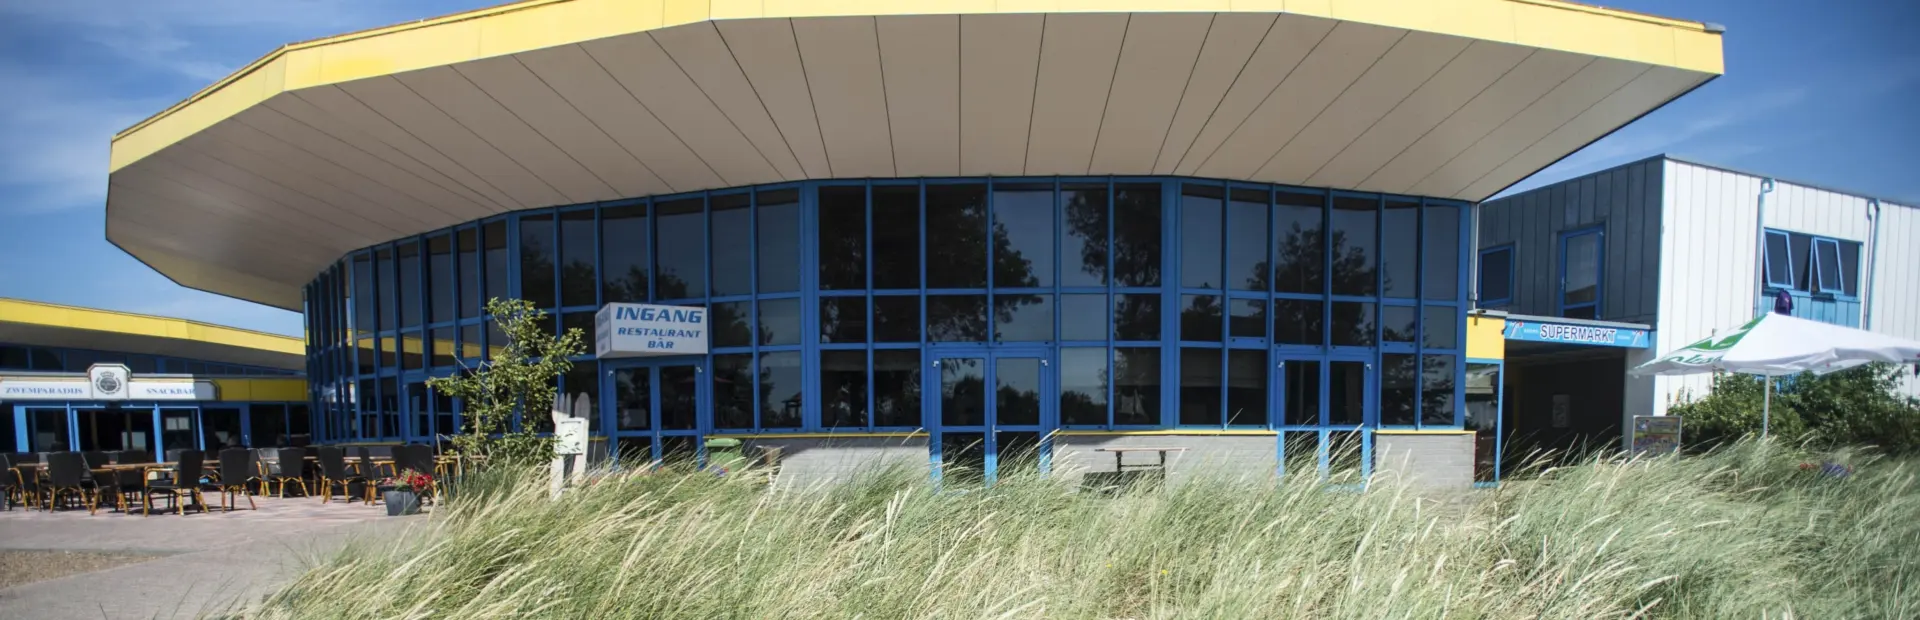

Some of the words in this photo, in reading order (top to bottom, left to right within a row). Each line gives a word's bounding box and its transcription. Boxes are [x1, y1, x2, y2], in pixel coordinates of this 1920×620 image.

[616, 306, 702, 323] INGANG
[617, 326, 701, 338] RESTAURANT
[1540, 324, 1615, 342] SUPERMARKT
[647, 340, 674, 349] BAR
